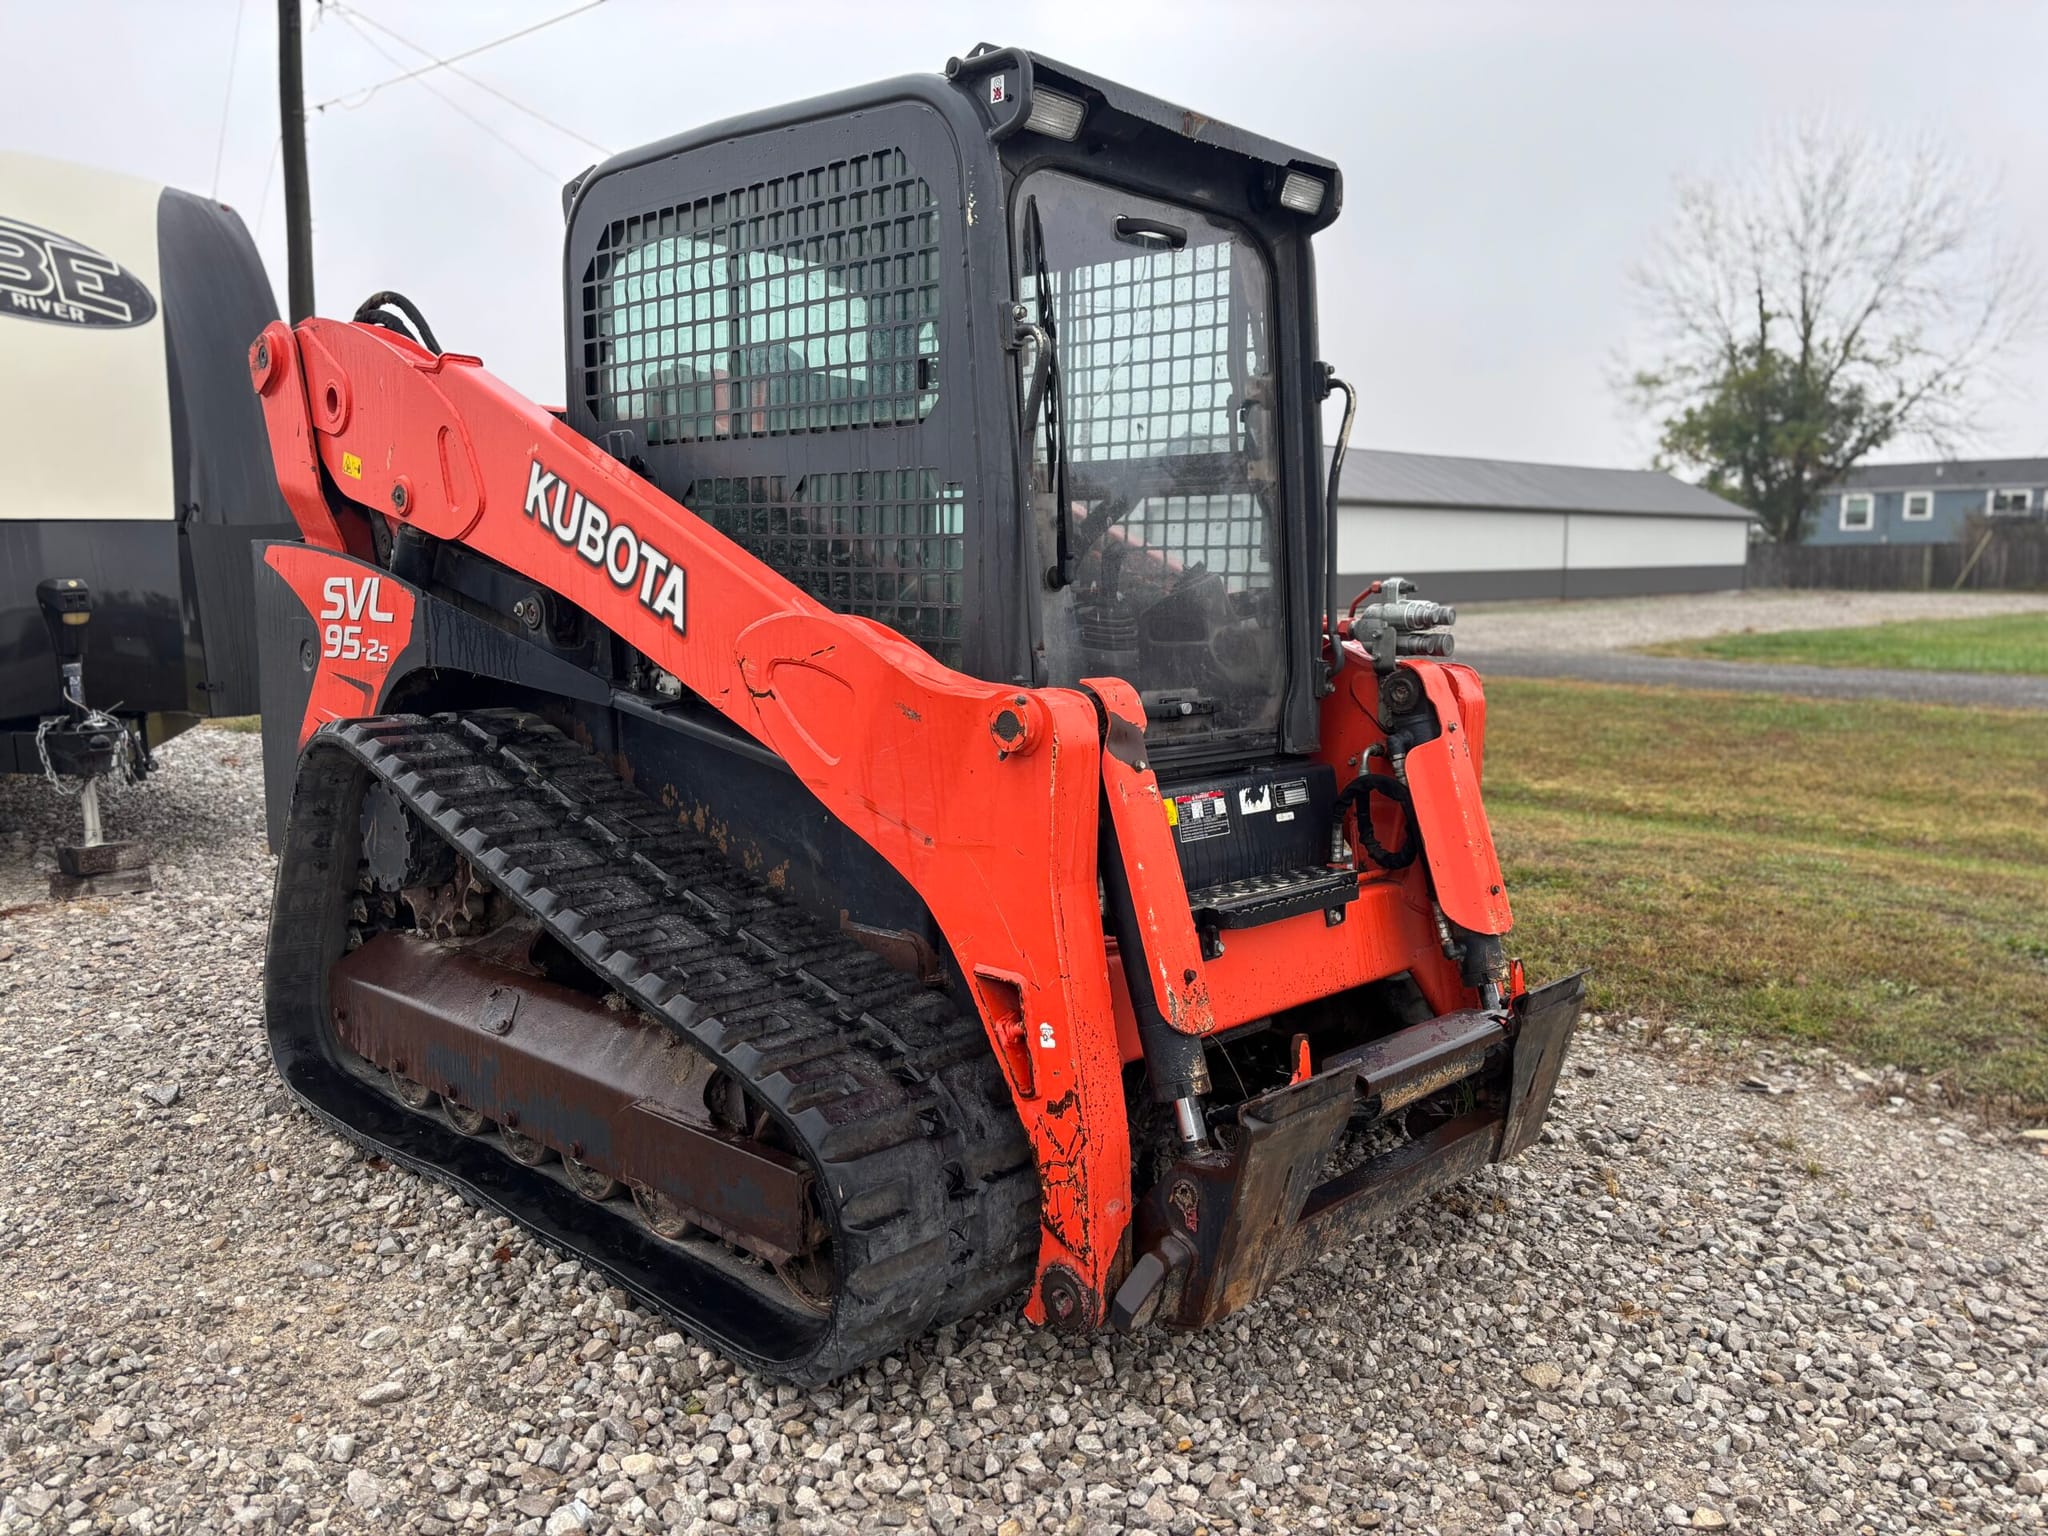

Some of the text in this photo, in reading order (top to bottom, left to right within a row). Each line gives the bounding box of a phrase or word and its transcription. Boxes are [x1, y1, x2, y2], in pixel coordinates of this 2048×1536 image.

[11, 292, 85, 322] RIVER
[524, 460, 686, 633] KUBOTA
[320, 577, 394, 622] SVL
